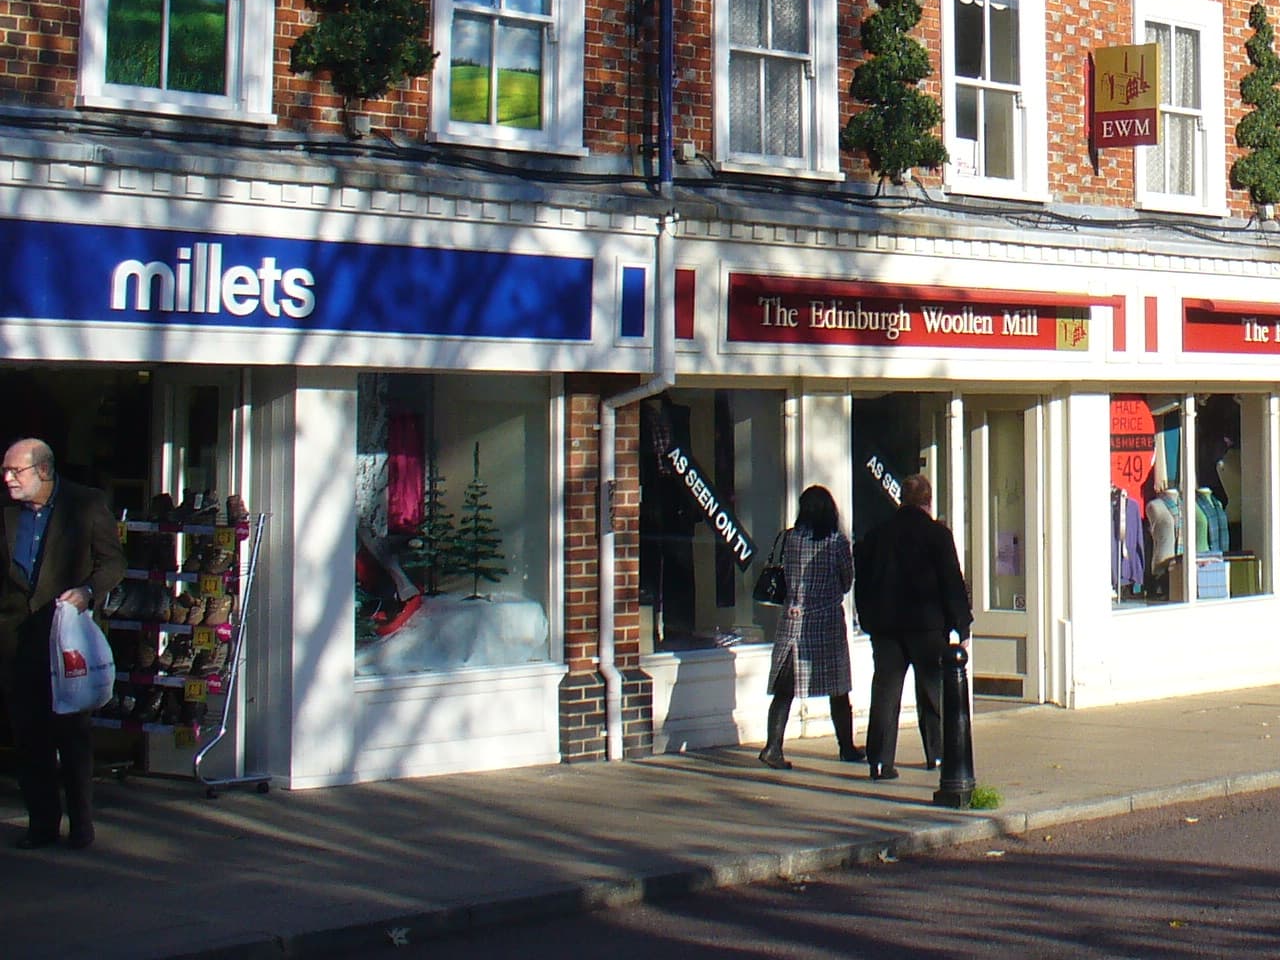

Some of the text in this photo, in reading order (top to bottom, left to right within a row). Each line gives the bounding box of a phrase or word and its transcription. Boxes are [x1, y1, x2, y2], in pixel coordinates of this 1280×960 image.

[1102, 118, 1150, 138] EWM
[110, 242, 316, 318] millets
[758, 296, 1038, 339] The Edinburgh Woollen Mill
[1242, 319, 1268, 343] The
[1116, 400, 1141, 415] HALF
[1112, 417, 1143, 432] PRICE
[866, 455, 884, 480] AS
[668, 447, 753, 562] AS SEEN ON TV
